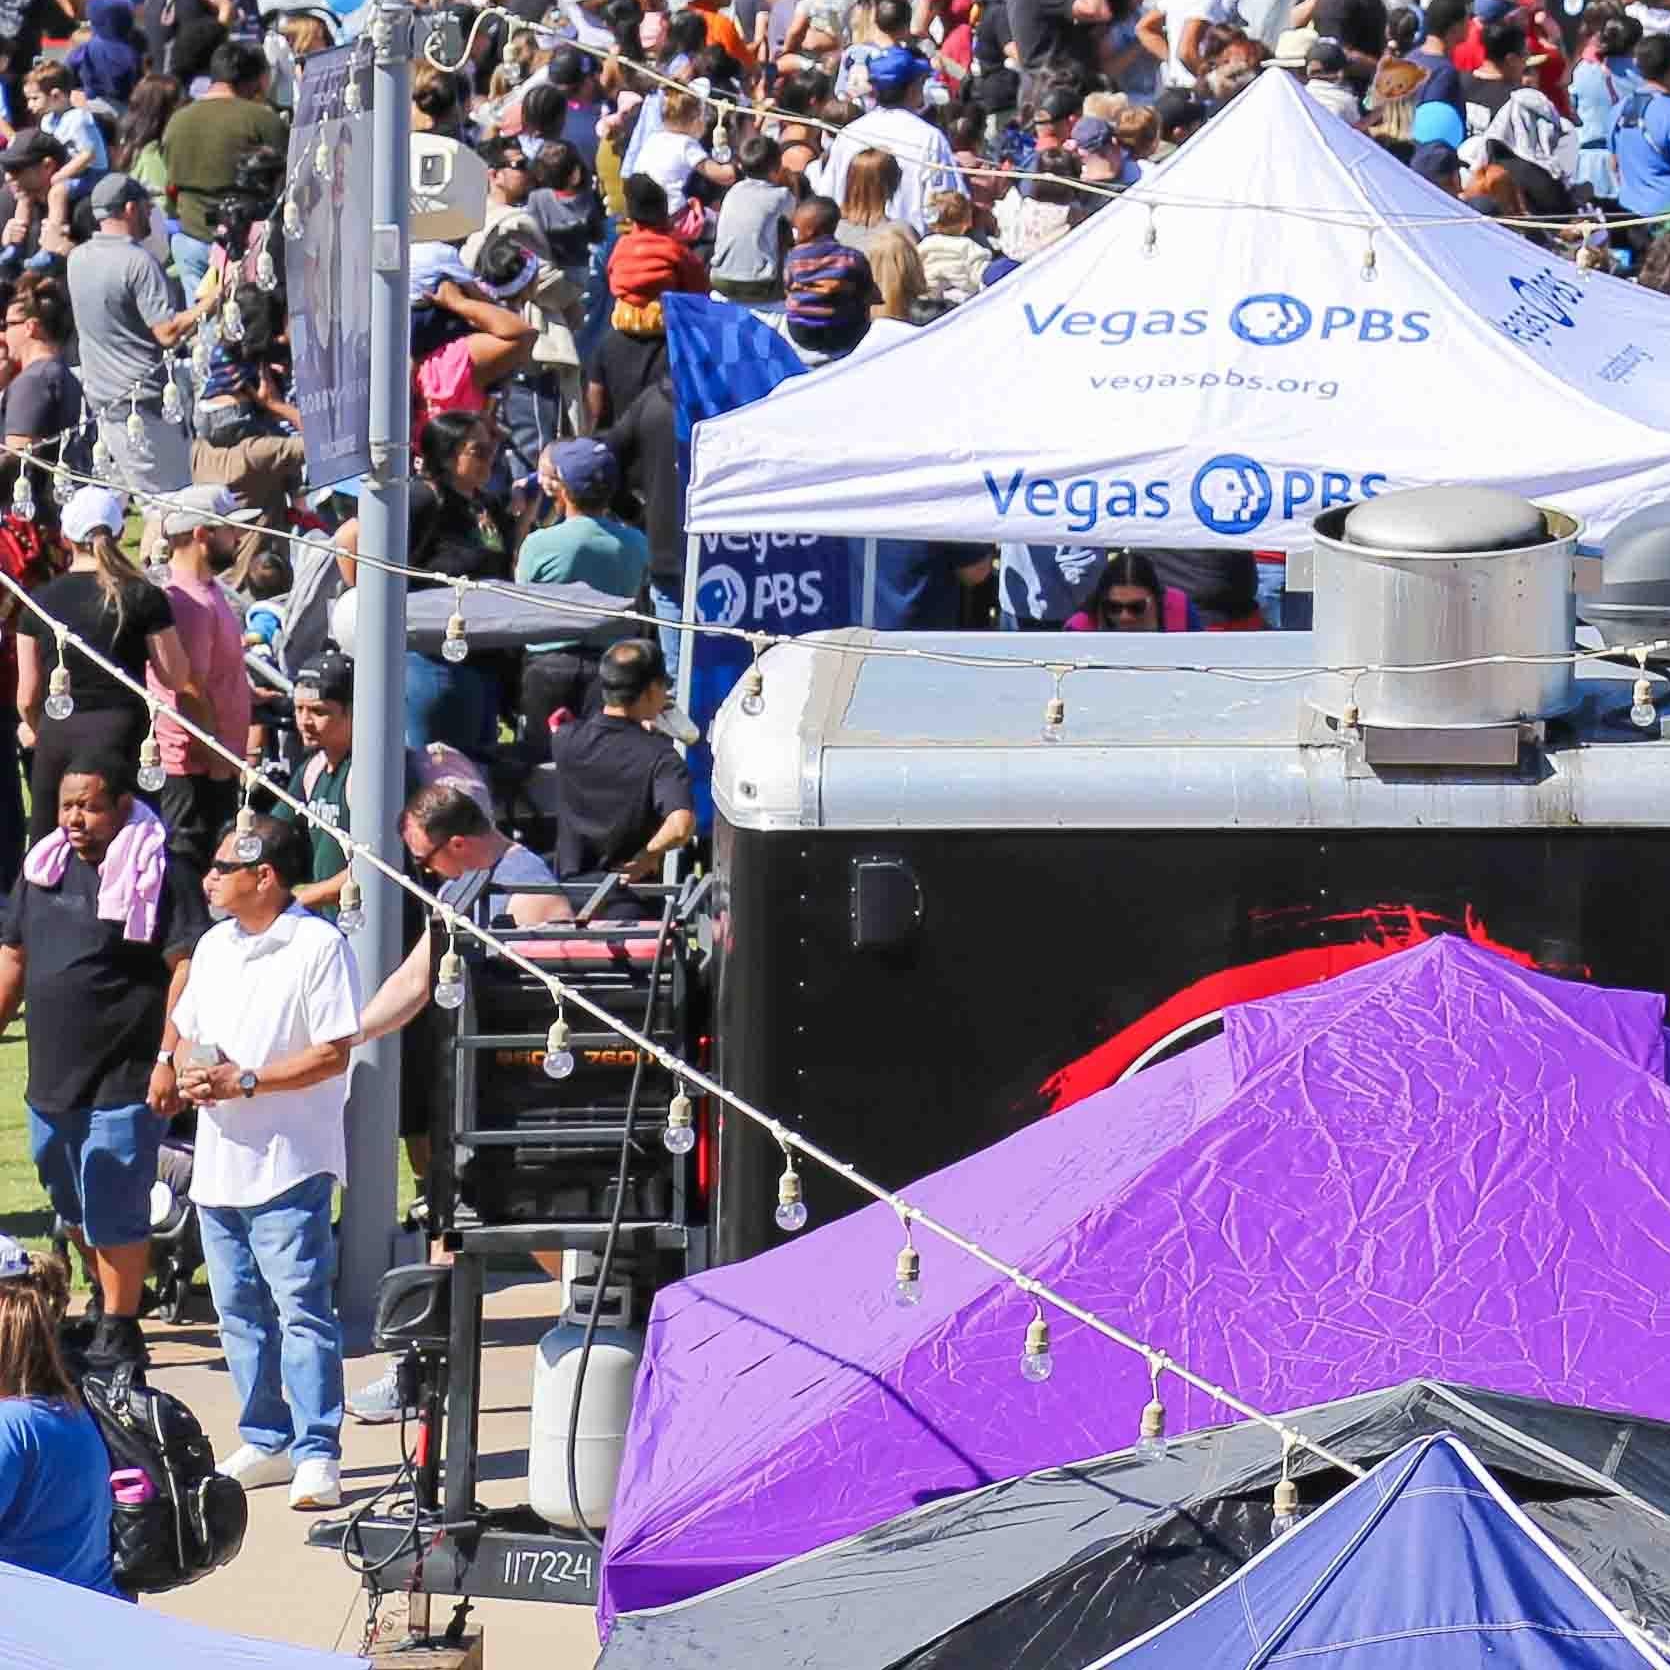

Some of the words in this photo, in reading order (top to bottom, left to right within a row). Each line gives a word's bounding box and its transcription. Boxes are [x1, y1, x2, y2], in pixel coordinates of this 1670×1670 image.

[1023, 302, 1208, 346] Vegas
[1315, 303, 1432, 345] PBS
[1088, 366, 1342, 401] vegaspbs.org
[983, 468, 1170, 532] Vegas
[752, 570, 823, 619] PBS
[503, 1550, 593, 1590] 117224
